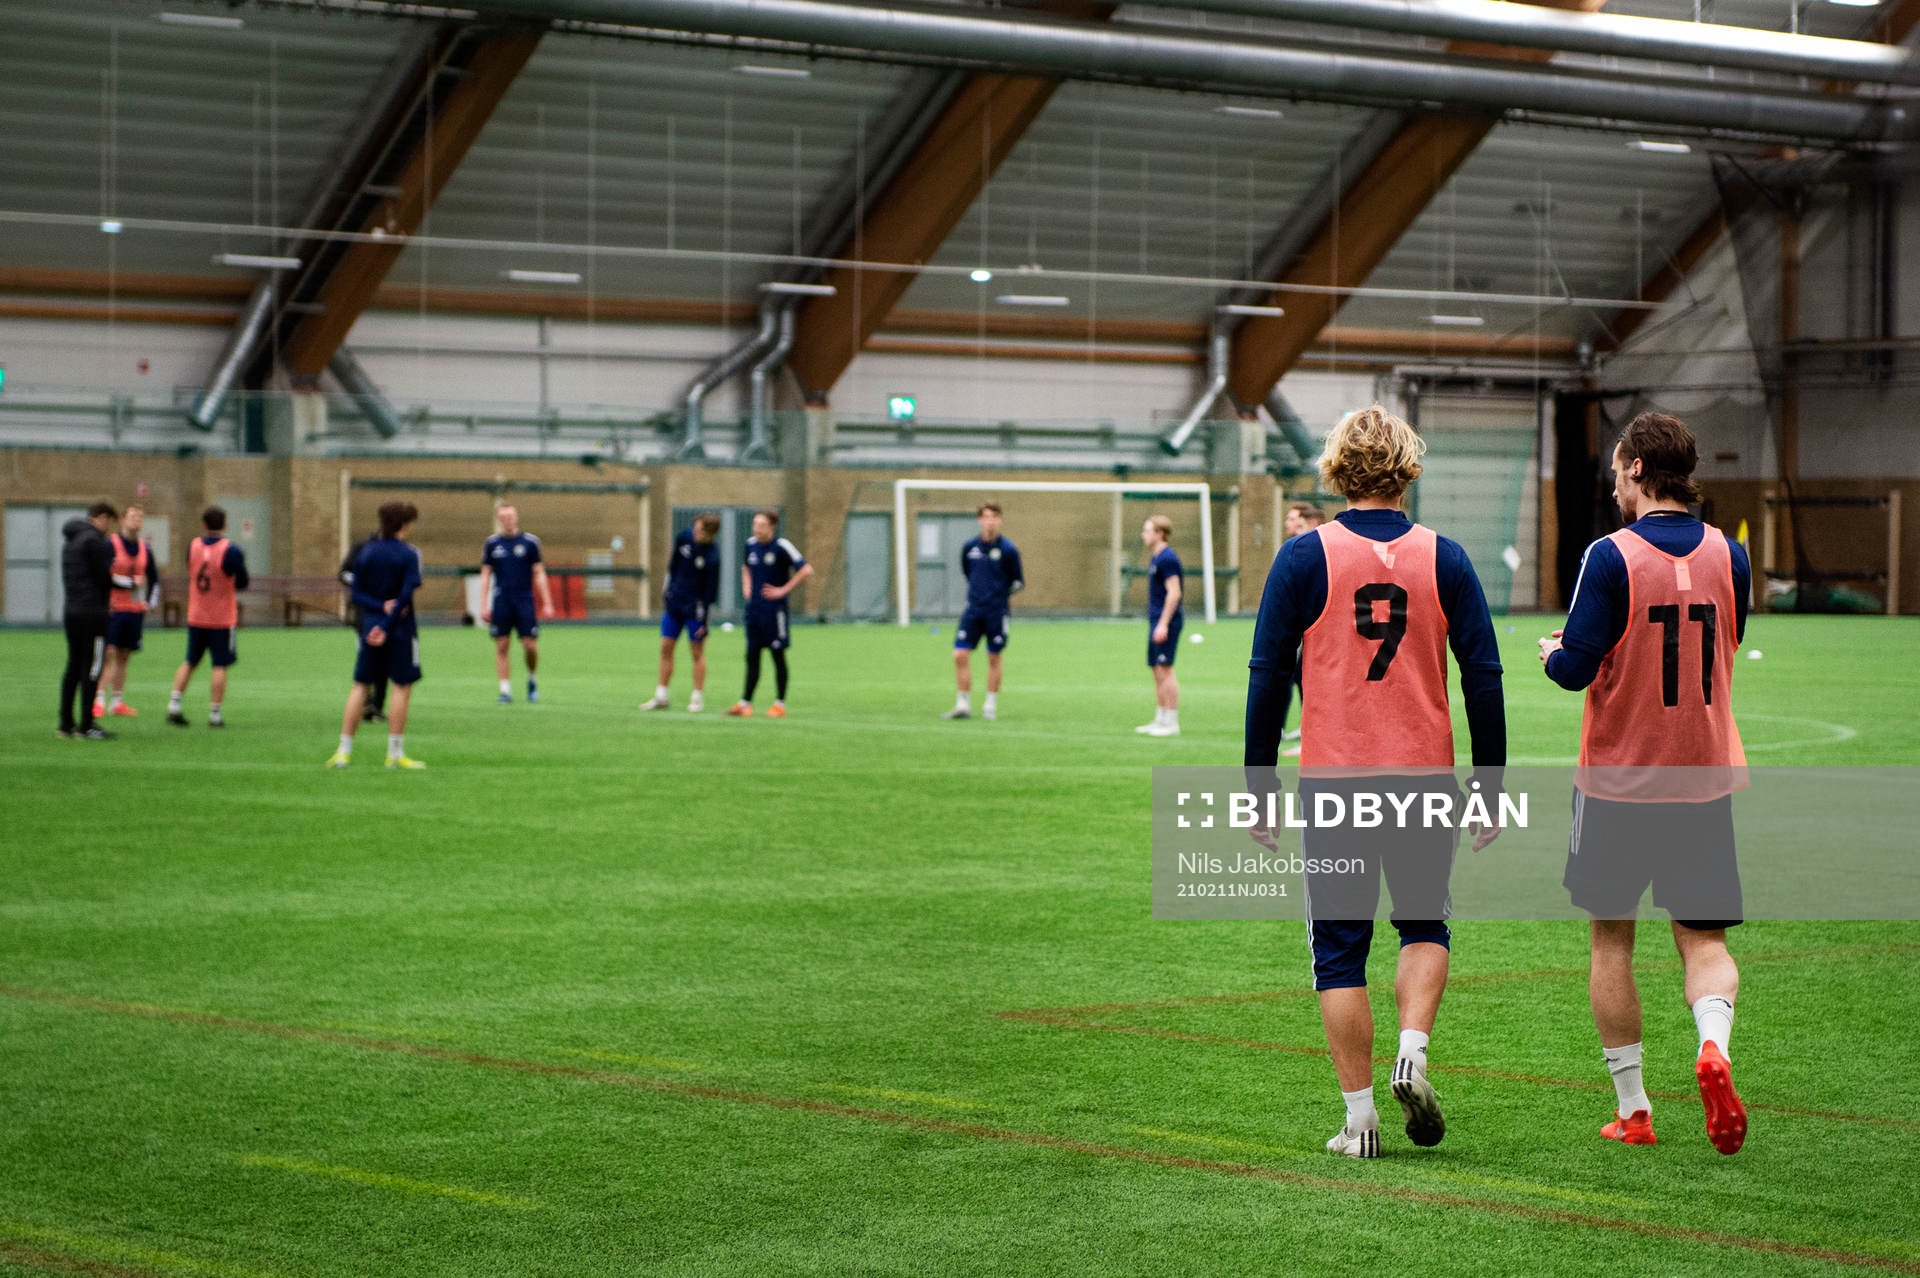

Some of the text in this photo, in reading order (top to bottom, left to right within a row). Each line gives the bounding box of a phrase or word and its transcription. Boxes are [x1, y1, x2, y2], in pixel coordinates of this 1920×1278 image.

[196, 561, 211, 594] 6
[1355, 583, 1408, 681] 9
[1648, 604, 1716, 707] 11
